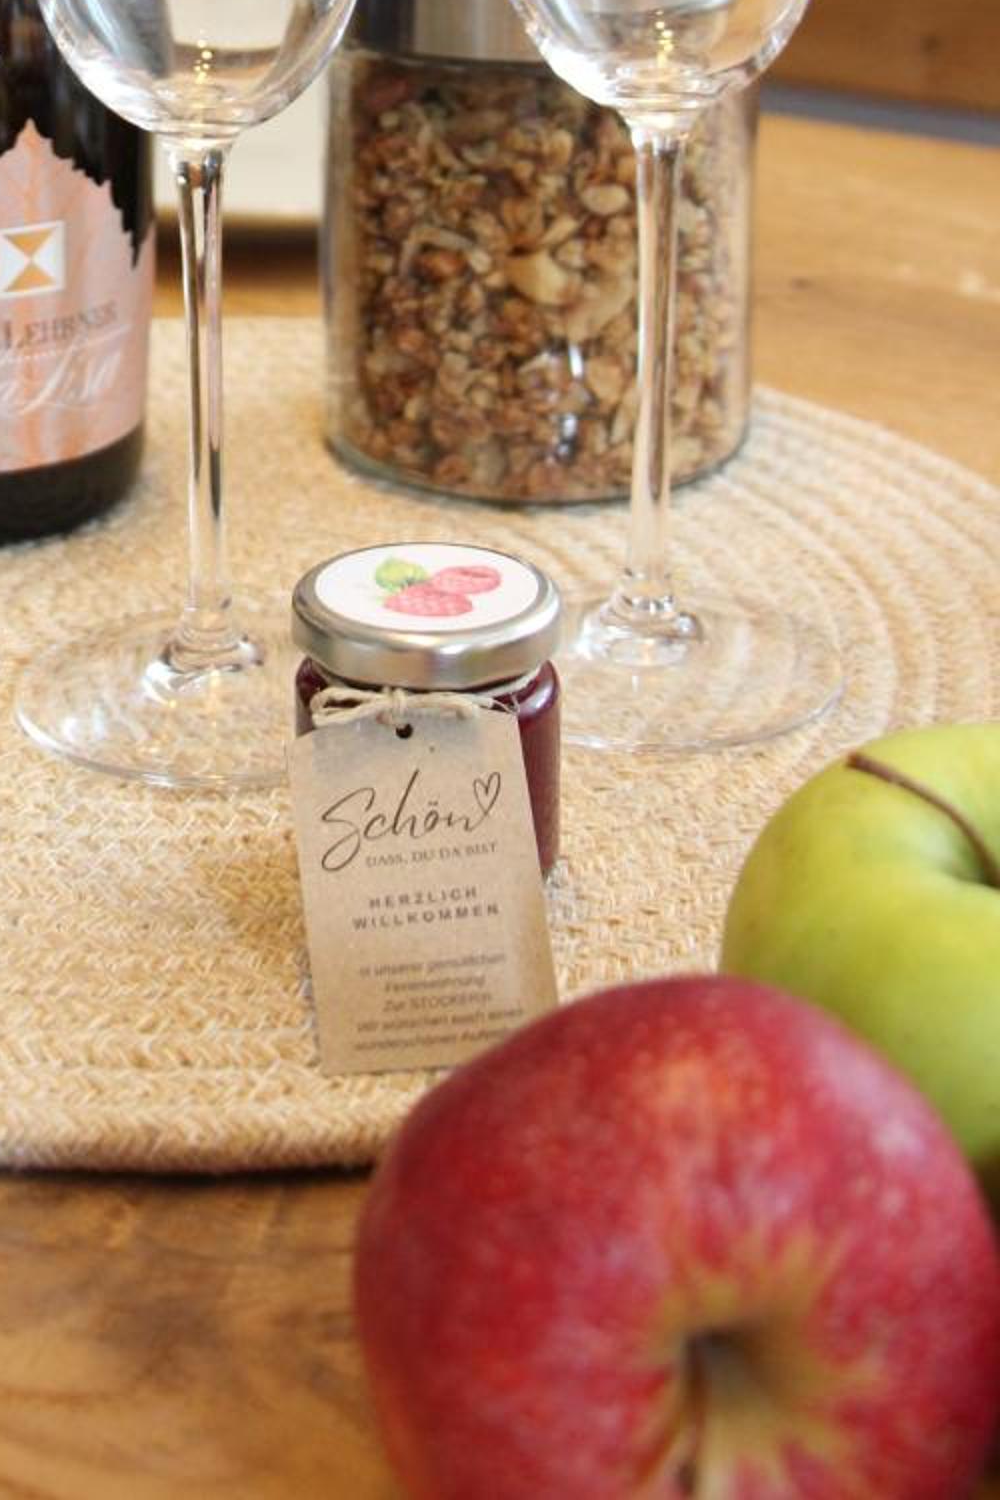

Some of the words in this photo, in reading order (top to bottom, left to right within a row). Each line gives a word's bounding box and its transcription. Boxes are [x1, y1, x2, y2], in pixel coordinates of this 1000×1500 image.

[321, 768, 476, 872] Schön
[369, 886, 477, 909] HERZLICH
[352, 903, 499, 929] WILLKOMMEN
